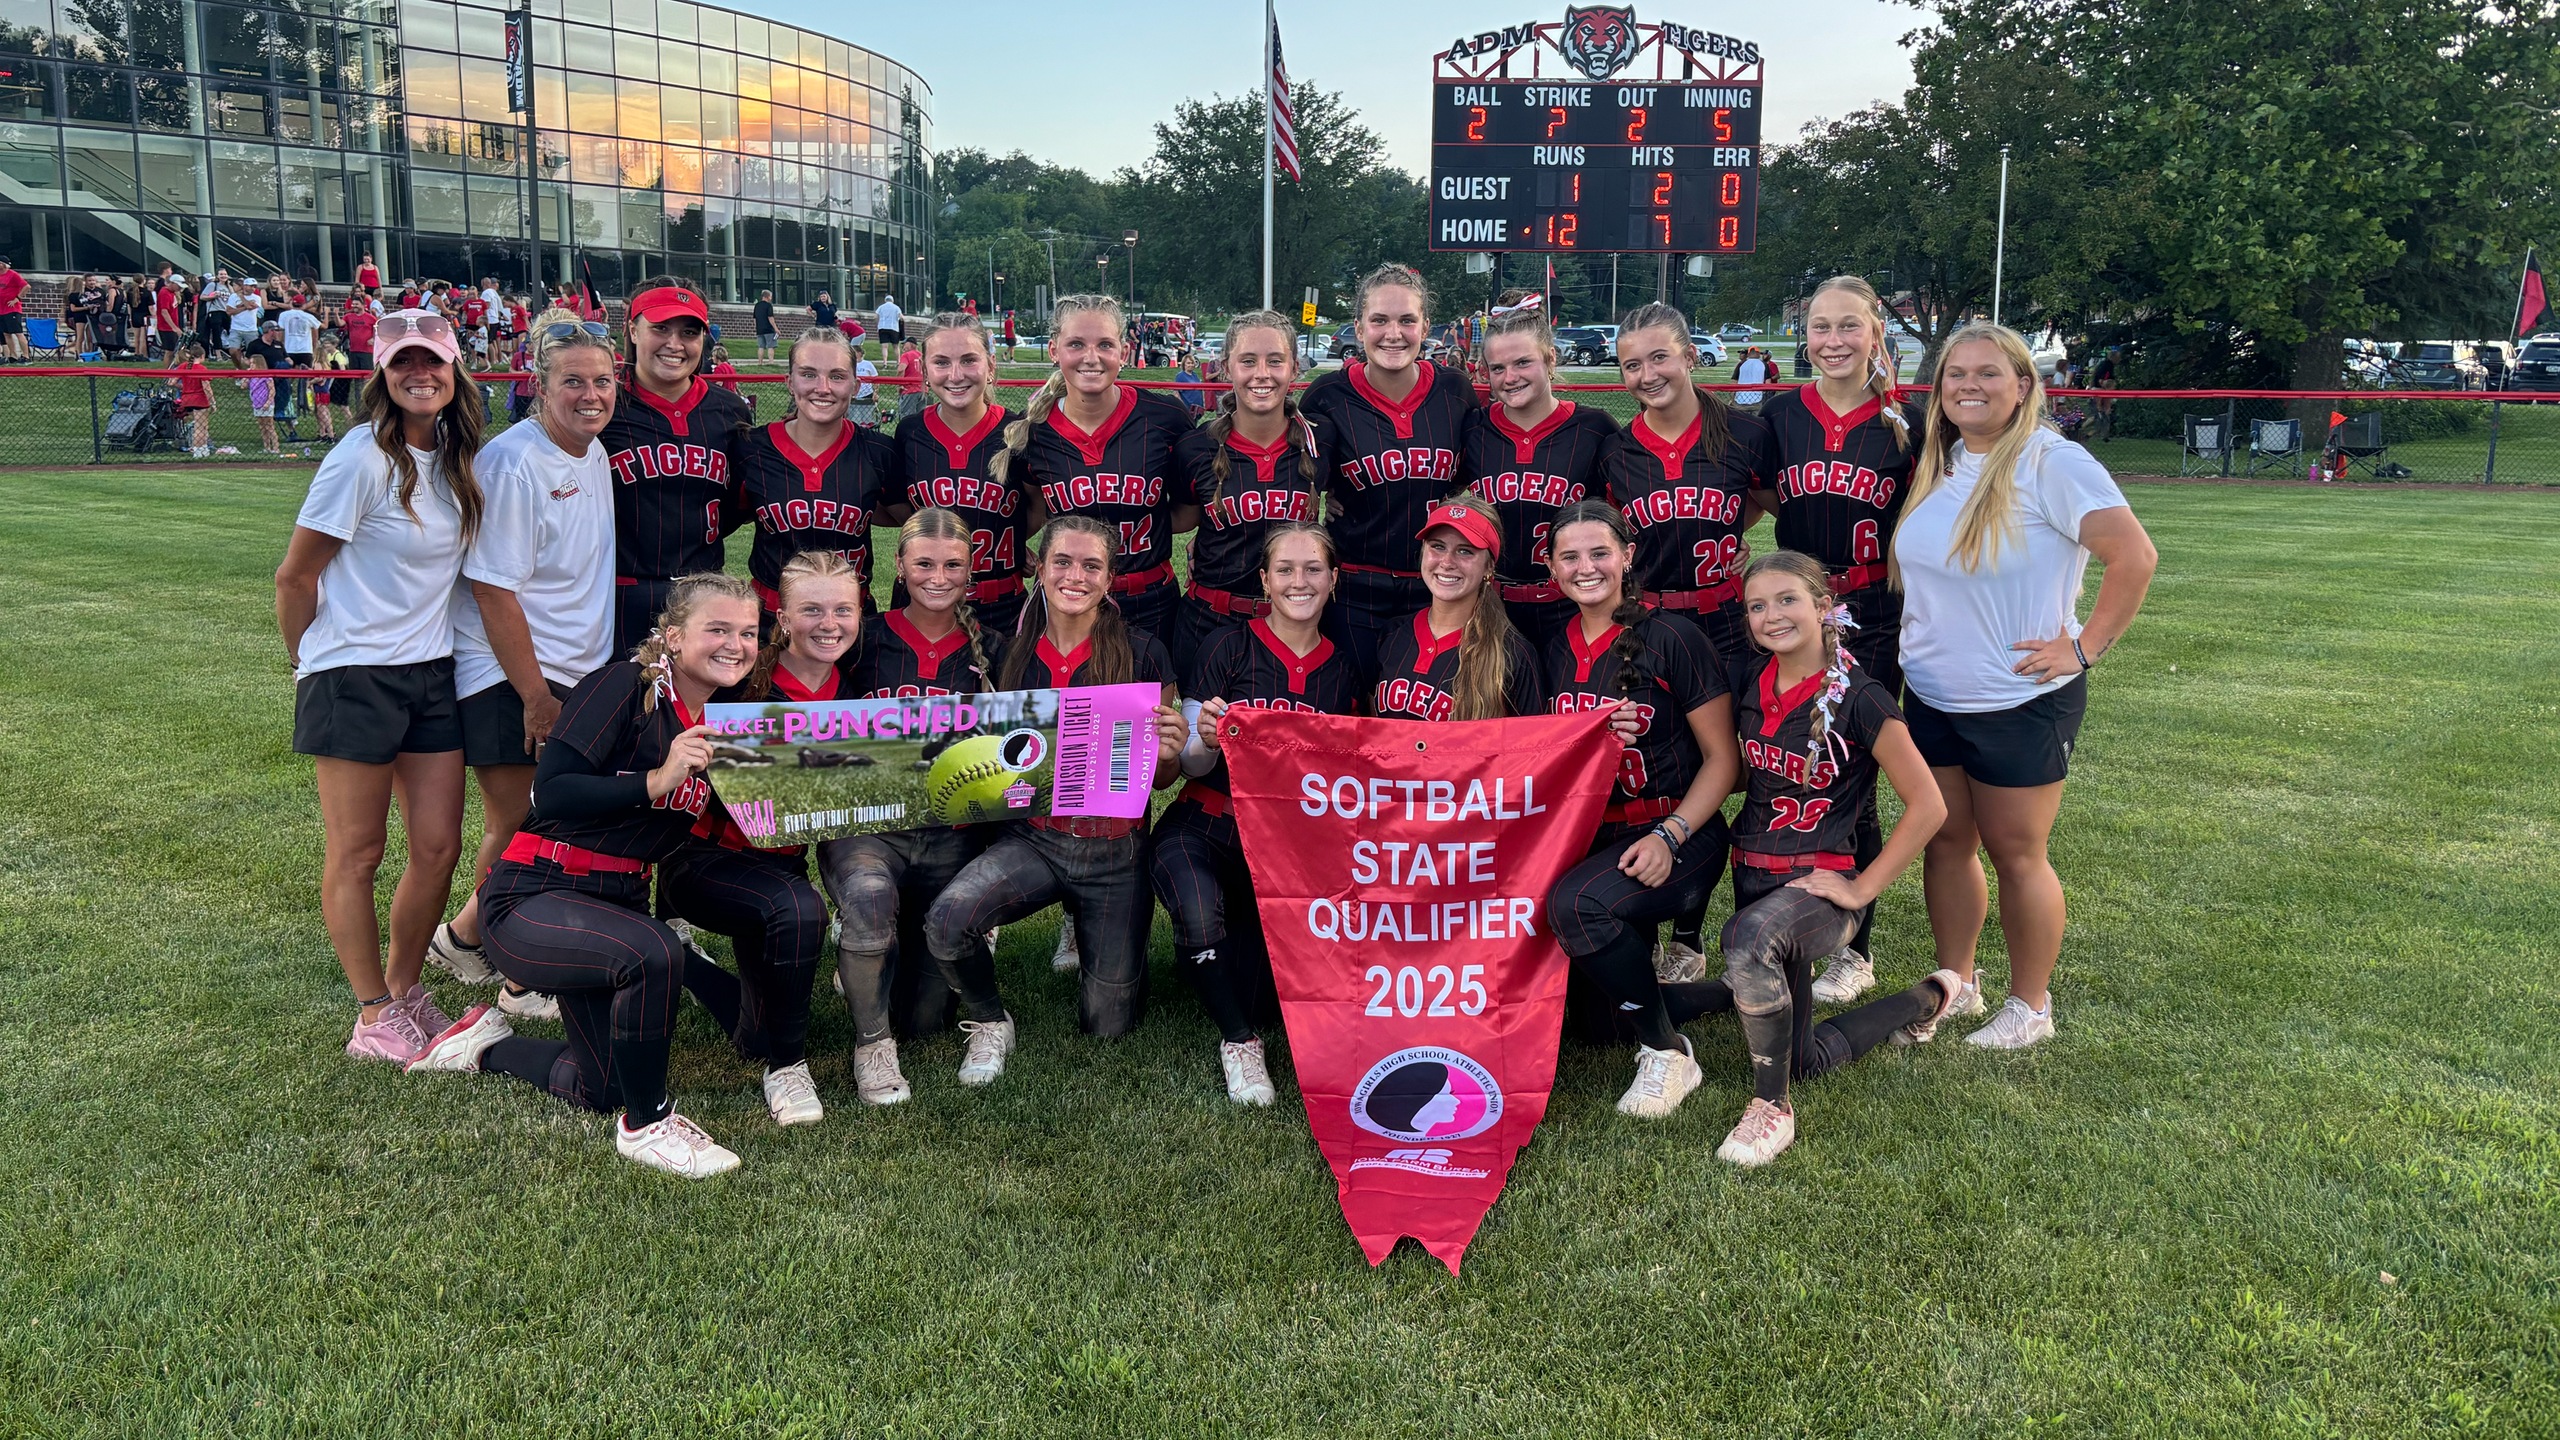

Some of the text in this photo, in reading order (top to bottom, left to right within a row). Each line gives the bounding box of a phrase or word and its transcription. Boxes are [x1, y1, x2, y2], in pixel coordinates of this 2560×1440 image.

[1445, 20, 1760, 66] ADM TIGERS
[515, 65, 524, 107] ADM
[1454, 87, 1752, 108] BALL STRIKE OUT INNING
[1467, 107, 1487, 141] 2
[1627, 108, 1647, 142] 2
[1713, 109, 1732, 142] 5
[1533, 147, 1750, 167] RUNS HITS ERR
[1441, 177, 1510, 200] GUEST
[1573, 172, 1740, 206] 1 2 0
[1441, 219, 1507, 243] HOME
[1547, 213, 1739, 248] 12 7 0
[609, 443, 730, 490] TIGER
[1341, 448, 1460, 491] TIGER
[1777, 460, 1896, 510] TIGERS
[907, 476, 1020, 517] TIGERS
[1042, 473, 1163, 514] TIGERS
[1470, 472, 1586, 508] TIGERS
[1621, 487, 1742, 535] TIGERS
[756, 499, 873, 537] TIGERS
[971, 526, 1015, 573] 24
[1853, 519, 1880, 565] 6
[835, 544, 867, 584] 7
[1375, 678, 1454, 722] IGER
[707, 704, 979, 742] TICKET PUNCHED
[1058, 698, 1091, 807] ADMISSION TICKET
[1141, 717, 1153, 790] ADMIT ONE
[1739, 739, 1841, 789] GERS
[1088, 769, 1096, 790] JULY
[1300, 772, 1546, 821] SOFTBALL
[785, 803, 905, 833] STATE SOFTBALL TOURNAMENT
[1351, 840, 1496, 885] STATE
[1308, 897, 1537, 942] QUALIFIER
[1364, 964, 1487, 1018] 2025
[1359, 1070, 1381, 1097] GIRLS
[1380, 1055, 1406, 1072] HIGH
[1408, 1051, 1451, 1061] SCHOOL
[1453, 1057, 1494, 1091] ATHLETIC
